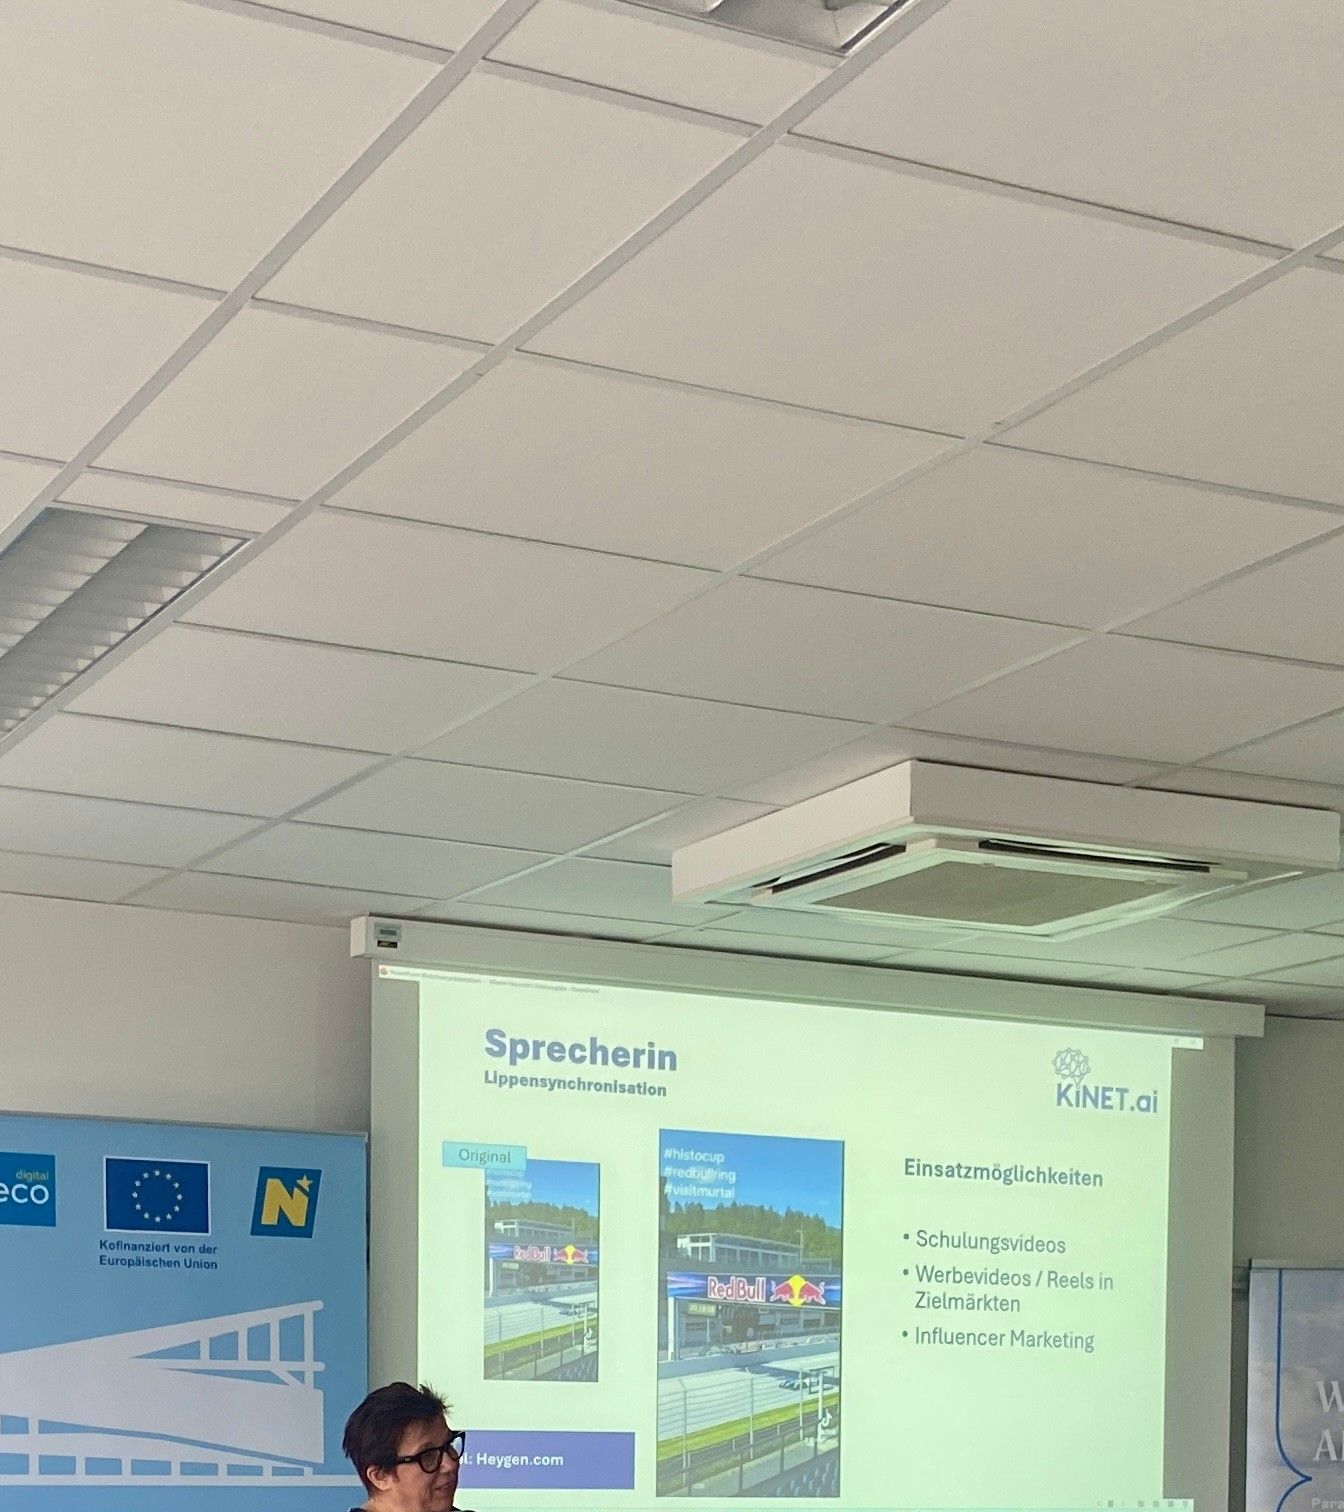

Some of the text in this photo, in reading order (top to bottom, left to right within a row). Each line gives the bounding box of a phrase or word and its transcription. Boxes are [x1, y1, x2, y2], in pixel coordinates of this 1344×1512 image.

[484, 1027, 678, 1072] Sprecherin
[484, 1070, 667, 1097] Lippensynchronisation
[1056, 1083, 1159, 1114] KiNET.ai
[458, 1147, 512, 1166] Original
[15, 1168, 50, 1183] digital
[904, 1158, 1104, 1188] Einsatzmöglichkeiten
[99, 1239, 218, 1255] Kofinanziert von der
[916, 1229, 1067, 1255] Schulungsvideos
[99, 1253, 218, 1271] Europäischen Union
[916, 1264, 1032, 1288] Werbevideos
[1047, 1270, 1096, 1292] Reels
[1099, 1271, 1114, 1291] in
[914, 1291, 1021, 1313] Zielmärkten
[914, 1327, 1095, 1353] Influencer Marketing
[476, 1452, 564, 1469] Heygen.com
